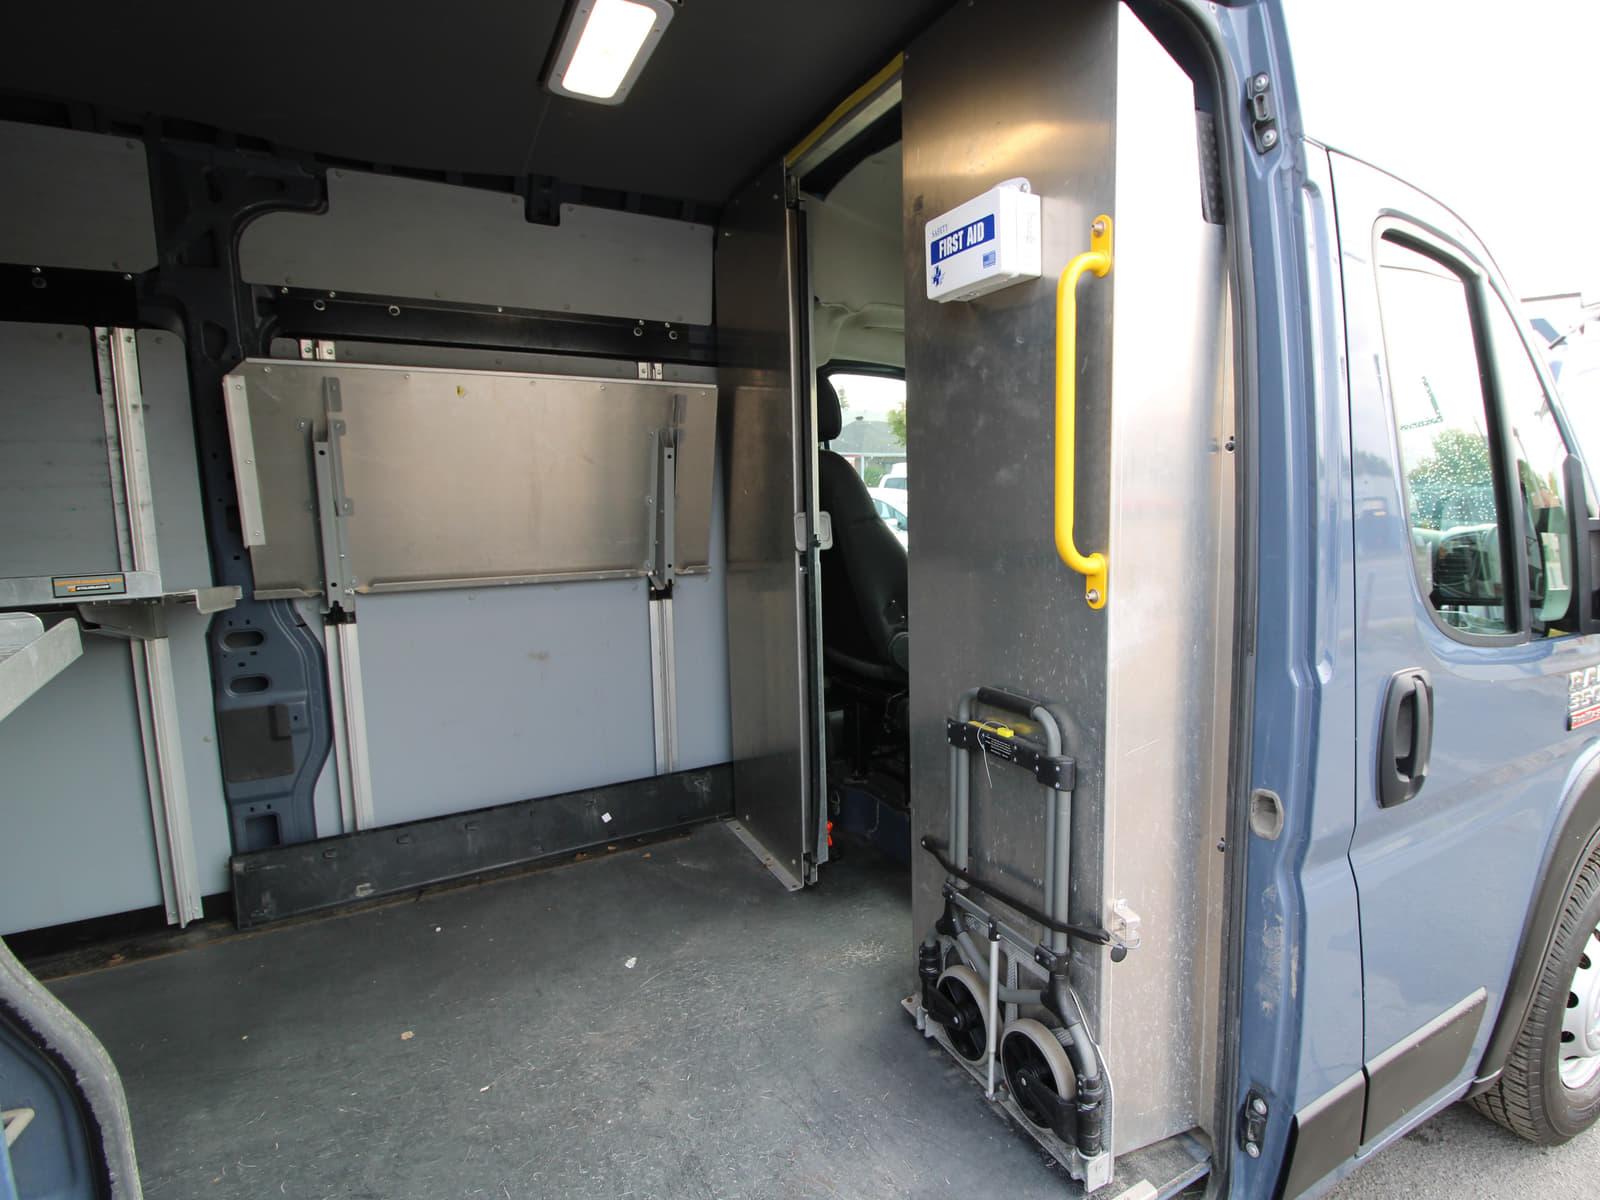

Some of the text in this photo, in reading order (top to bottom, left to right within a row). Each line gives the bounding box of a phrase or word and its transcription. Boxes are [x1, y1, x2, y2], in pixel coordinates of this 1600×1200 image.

[939, 222, 985, 259] FIRST AID
[1569, 665, 1600, 691] RA
